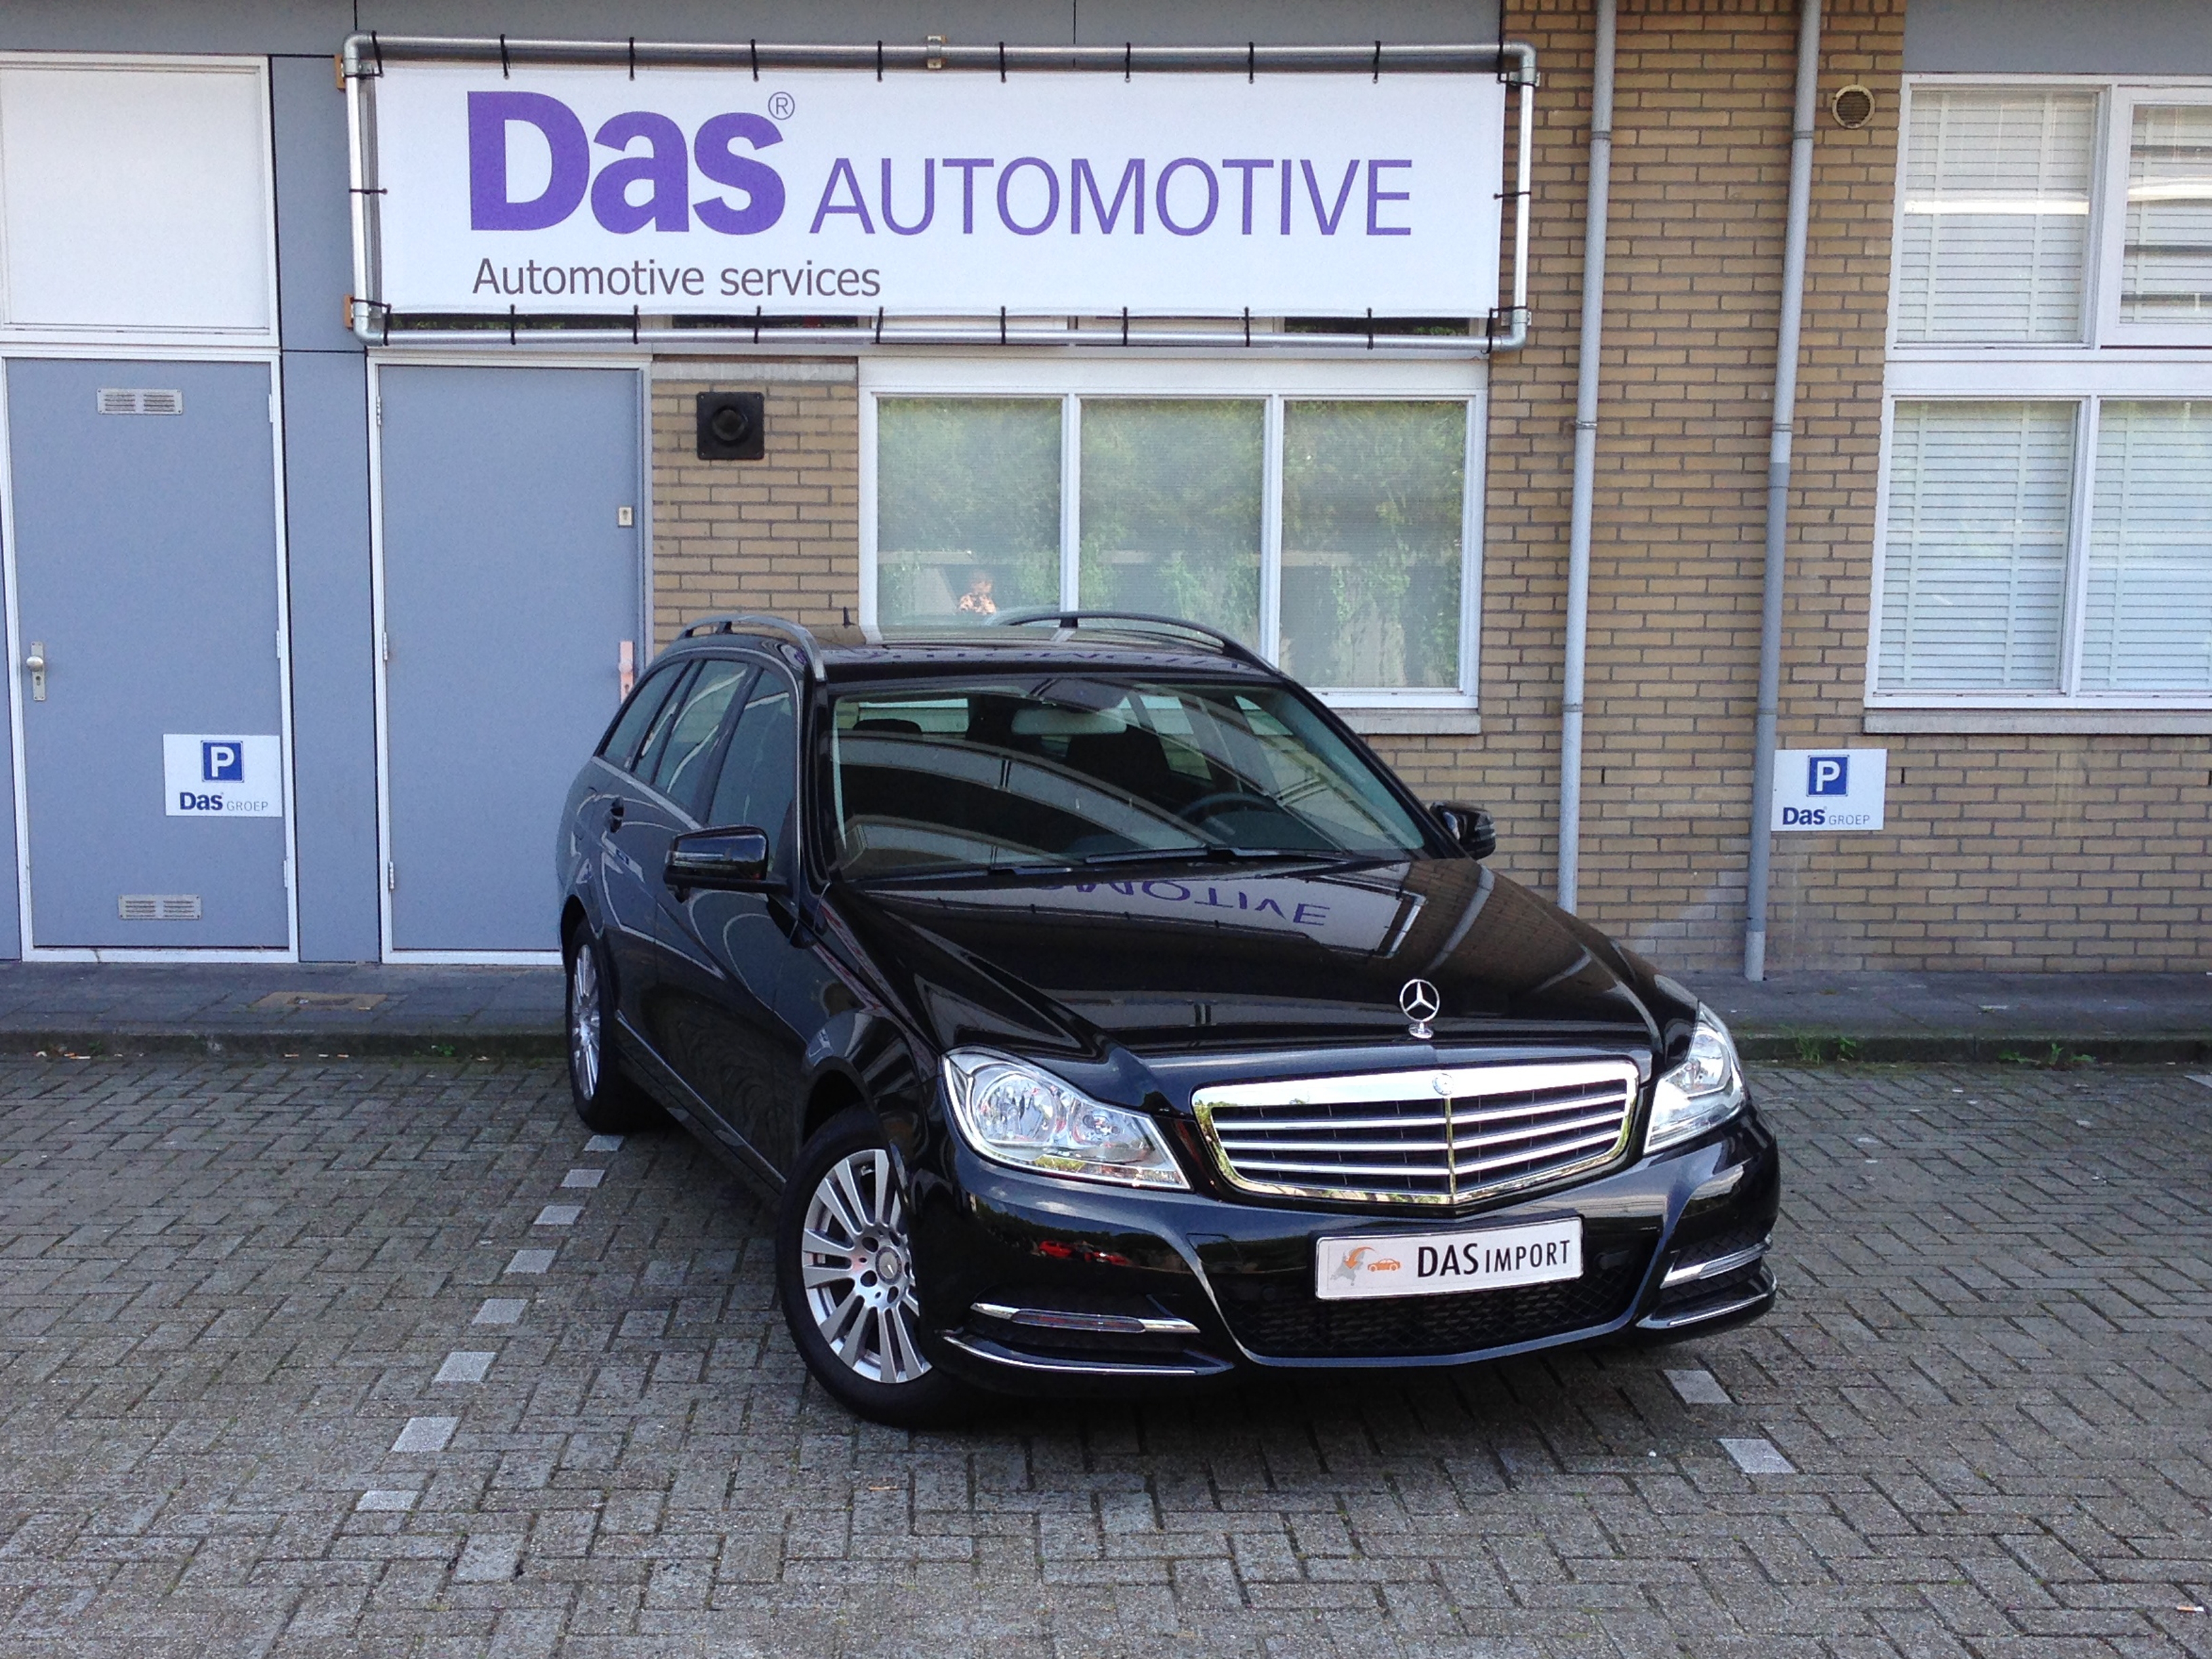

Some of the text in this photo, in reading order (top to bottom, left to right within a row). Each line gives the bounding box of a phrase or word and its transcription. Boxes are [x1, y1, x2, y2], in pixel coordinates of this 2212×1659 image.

[809, 157, 1412, 237] AUTOMOTIVE
[472, 258, 882, 297] Automotive services
[210, 745, 234, 778] P
[1816, 760, 1841, 792] P
[226, 801, 268, 812] GROEP
[1829, 815, 1870, 825] GROEP
[1417, 1240, 1570, 1278] DAS IMPORT
